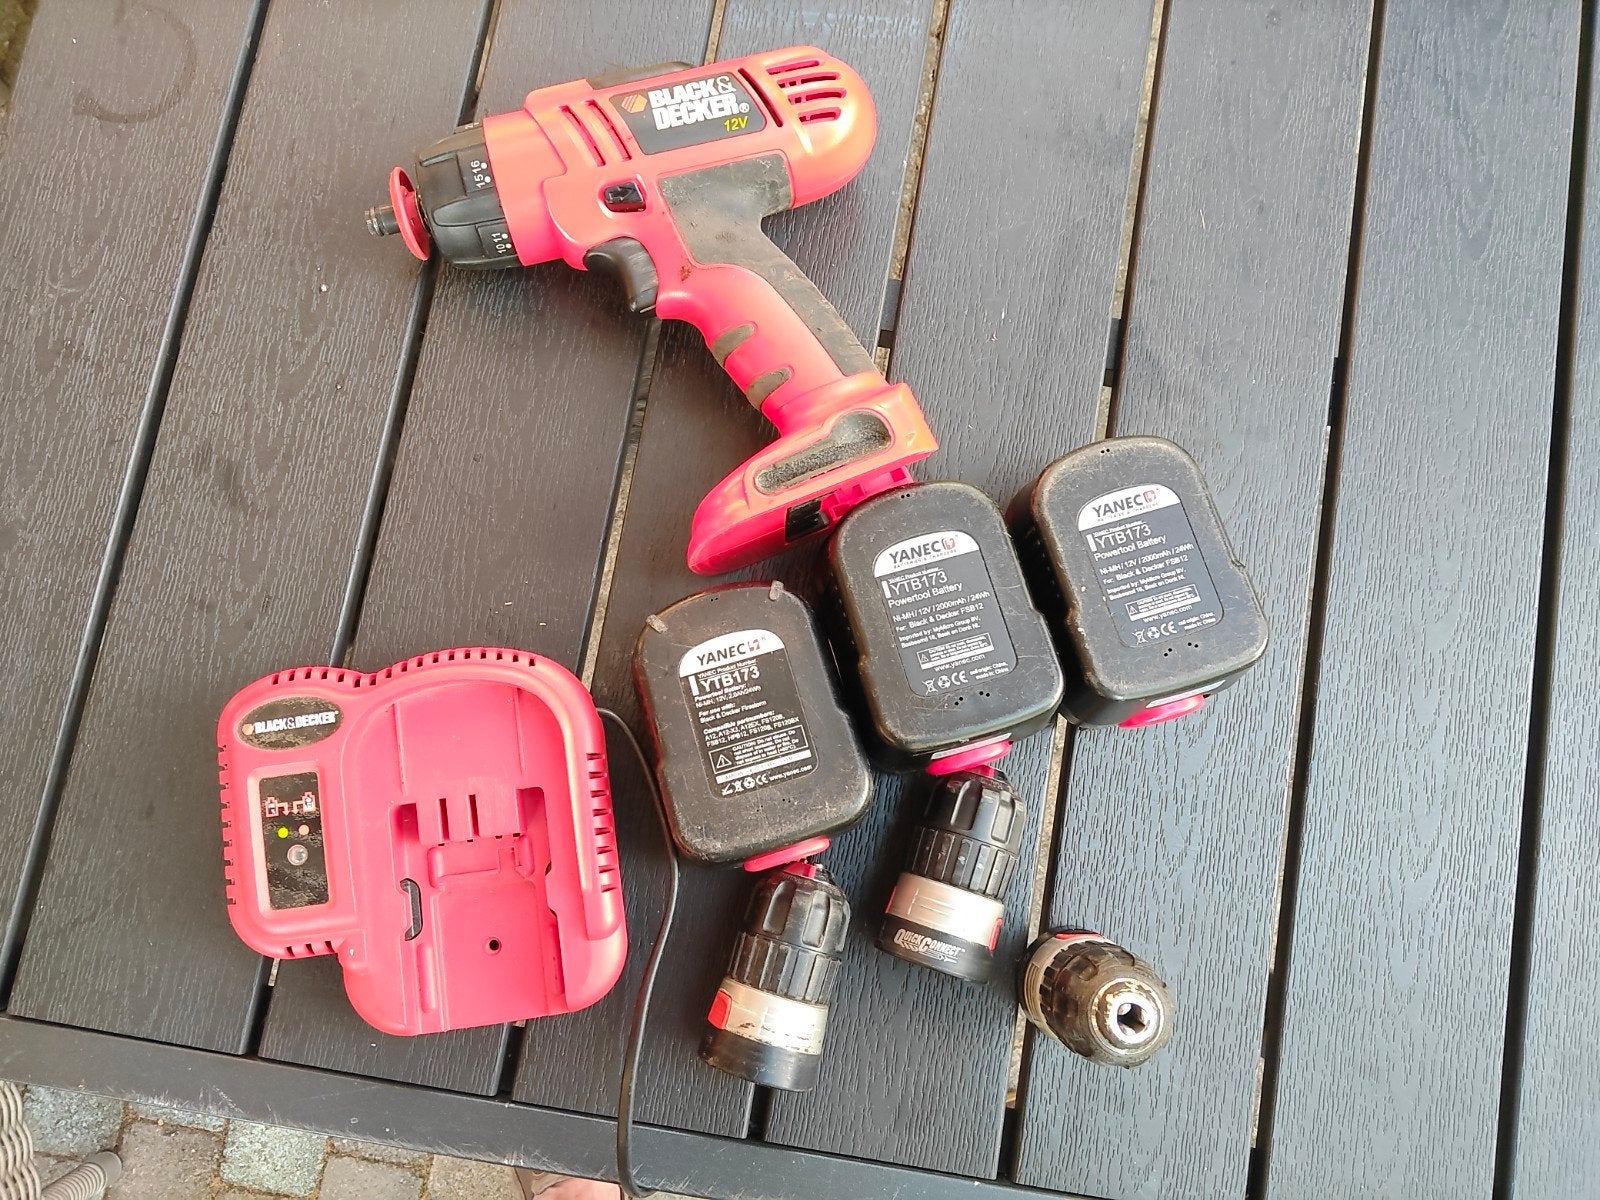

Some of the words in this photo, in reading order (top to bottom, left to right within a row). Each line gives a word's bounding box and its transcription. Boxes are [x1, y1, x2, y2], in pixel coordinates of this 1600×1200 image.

[724, 116, 748, 131] 12V
[471, 160, 481, 174] 16
[474, 173, 486, 189] 15
[492, 232, 501, 243] 11
[496, 243, 506, 254] 10
[1092, 494, 1144, 518] YANEC
[1095, 524, 1151, 548] YTB173
[889, 540, 941, 564] YANEC
[1094, 543, 1136, 561] Powertool
[1137, 535, 1166, 549] Battery
[1125, 559, 1136, 567] 12V
[1175, 543, 1194, 553] 24Wh
[1116, 571, 1135, 580] Black
[1142, 562, 1165, 573] Decker
[1166, 555, 1188, 566] FSB12
[891, 571, 947, 595] YTB173
[888, 590, 931, 608] Powertool
[932, 583, 962, 596] Battery
[918, 607, 930, 615] 12V
[936, 598, 967, 611] 2000mAh
[909, 618, 928, 628] Black
[936, 610, 959, 621] Decker
[960, 603, 984, 614] FSB12
[899, 631, 923, 642] Imported
[697, 643, 746, 666] YANEC
[934, 654, 985, 672] www.yanec.com
[700, 666, 760, 692] YTB173
[700, 715, 715, 723] Black
[721, 708, 740, 717] Decker
